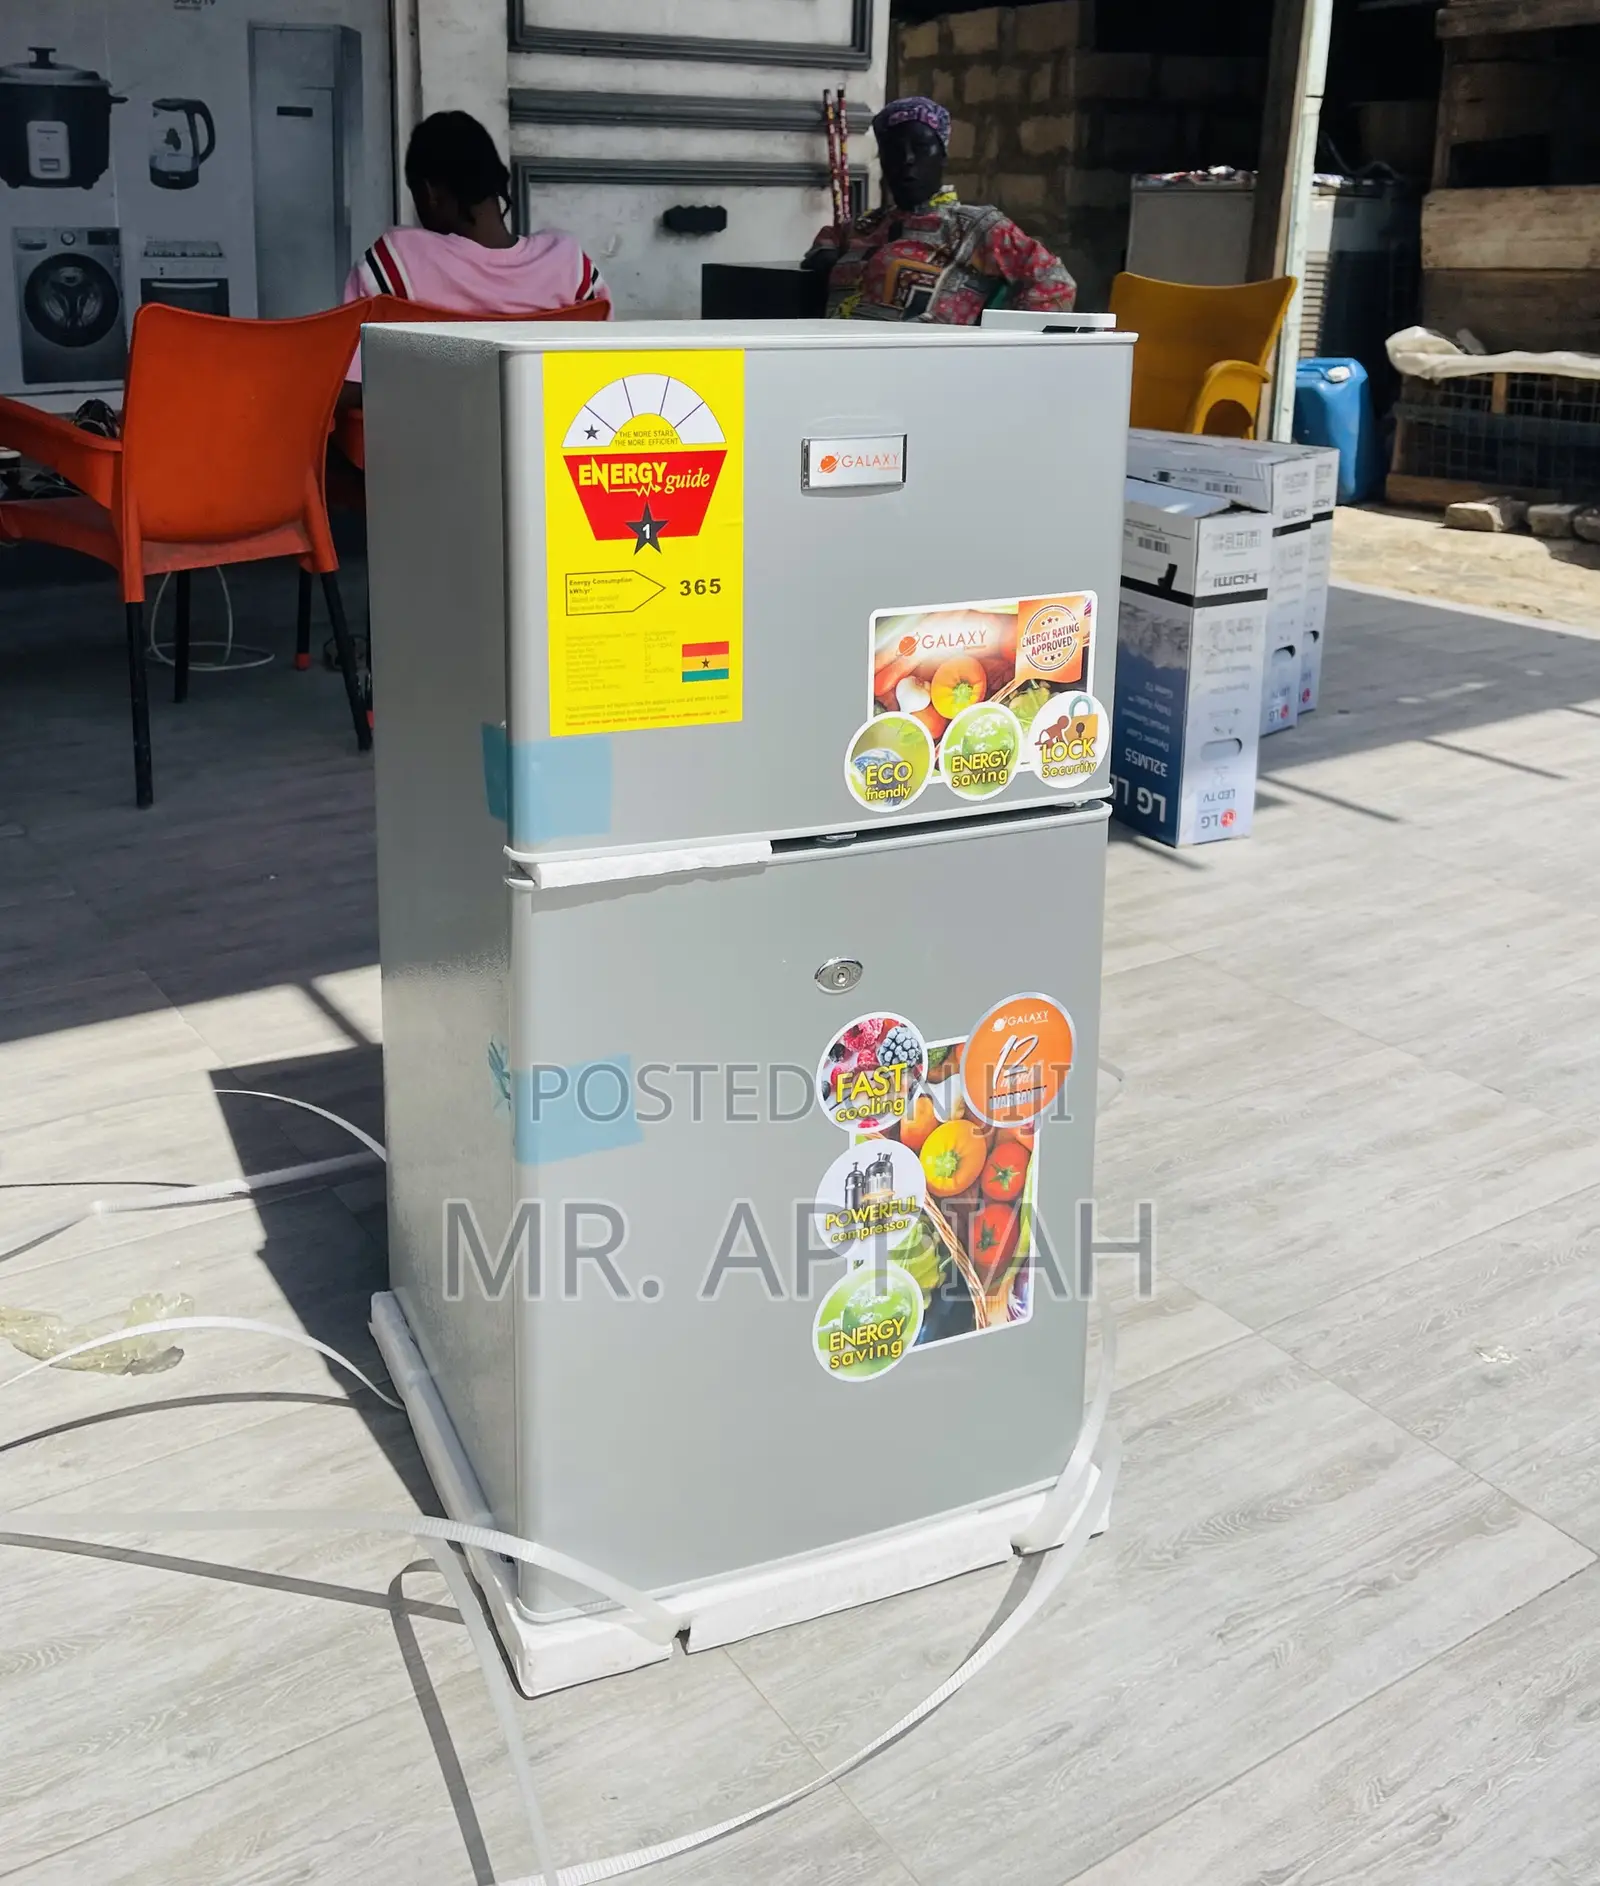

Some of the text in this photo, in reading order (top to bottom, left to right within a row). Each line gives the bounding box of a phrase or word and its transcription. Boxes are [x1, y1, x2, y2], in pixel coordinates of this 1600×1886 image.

[633, 430, 651, 438] MORE
[653, 429, 674, 437] STARS
[648, 438, 678, 446] EFFICIENT
[841, 452, 900, 468] GALAXY
[578, 457, 710, 494] ENERGY guide
[642, 523, 651, 540] 1
[569, 577, 633, 587] Energy Consumption
[679, 578, 722, 596] 365
[1213, 573, 1257, 588] HDMI
[921, 630, 988, 650] GALAXY
[1022, 622, 1080, 648] ENERGY RATING
[1031, 636, 1073, 657] APPROVED
[951, 749, 1010, 773] ENERGY
[1041, 737, 1096, 764] LOCK
[1042, 760, 1097, 779] Security
[1125, 747, 1168, 777] 32LM55
[865, 761, 913, 787] ECO
[951, 767, 1008, 788] saving
[865, 784, 911, 801] friendly
[1203, 788, 1235, 803] LED TV
[1137, 787, 1166, 823] LG
[1201, 814, 1218, 830] LG
[1007, 1010, 1049, 1026] GALAXY
[993, 1034, 1039, 1090] 12
[836, 1062, 907, 1104] FAST
[835, 1097, 905, 1123] cooling
[825, 1195, 921, 1230] POWERFUL
[831, 1218, 910, 1244] compressor
[829, 1316, 905, 1352] ENERGY
[830, 1339, 903, 1369] saving
